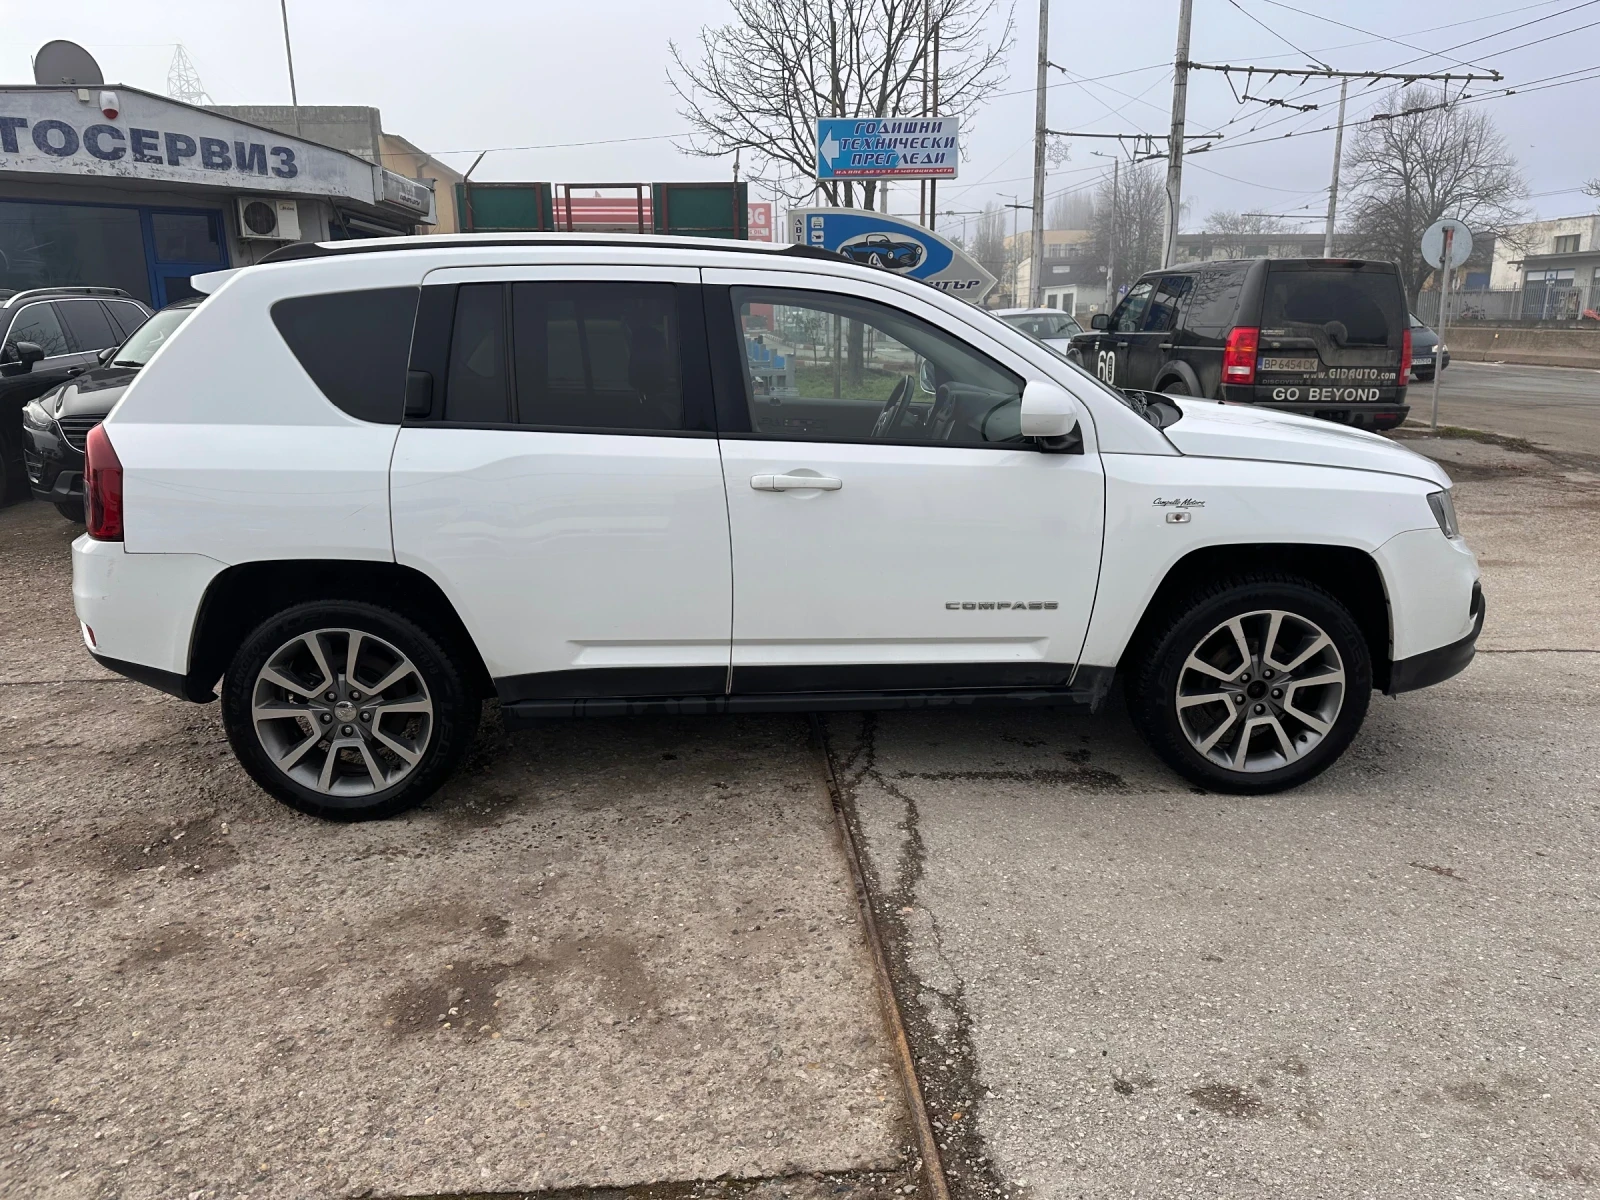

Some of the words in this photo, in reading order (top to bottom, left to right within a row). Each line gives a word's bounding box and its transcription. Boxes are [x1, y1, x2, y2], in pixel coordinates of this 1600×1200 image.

[854, 121, 943, 135] ГОДИШНИ
[0, 117, 298, 178] ТОСЕРВИЗ
[841, 136, 956, 150] ТЕХНИЧЕСКИ
[851, 152, 946, 165] ПРЕГЛЕДИ
[1279, 360, 1302, 370] 6454
[1303, 368, 1396, 380] www.GIDAUTO.com
[1272, 387, 1300, 401] GO
[1308, 388, 1380, 401] BEYOND
[945, 601, 1059, 610] COMPASS
